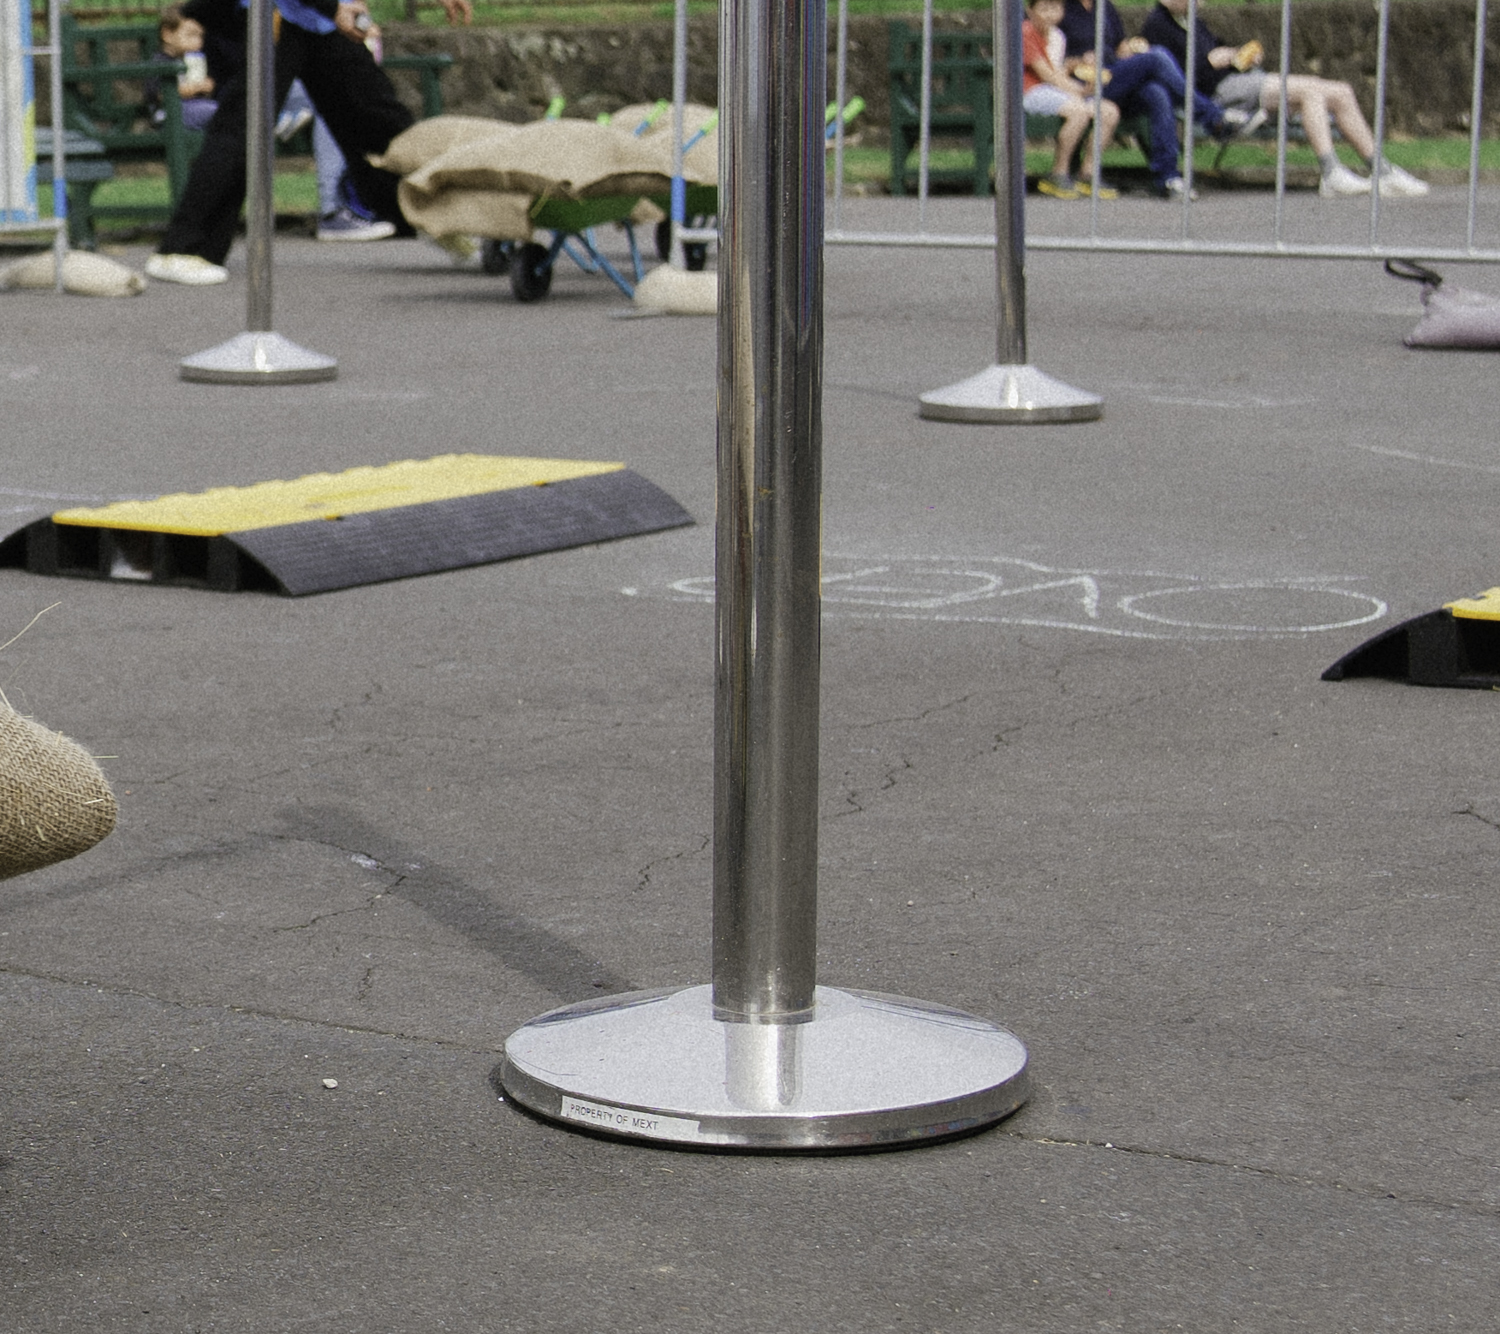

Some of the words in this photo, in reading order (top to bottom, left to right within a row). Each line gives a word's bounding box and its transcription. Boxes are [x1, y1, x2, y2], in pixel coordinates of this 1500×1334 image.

[570, 1103, 613, 1121] PROPERTY
[616, 1114, 629, 1125] OF
[632, 1117, 659, 1131] MEXT
